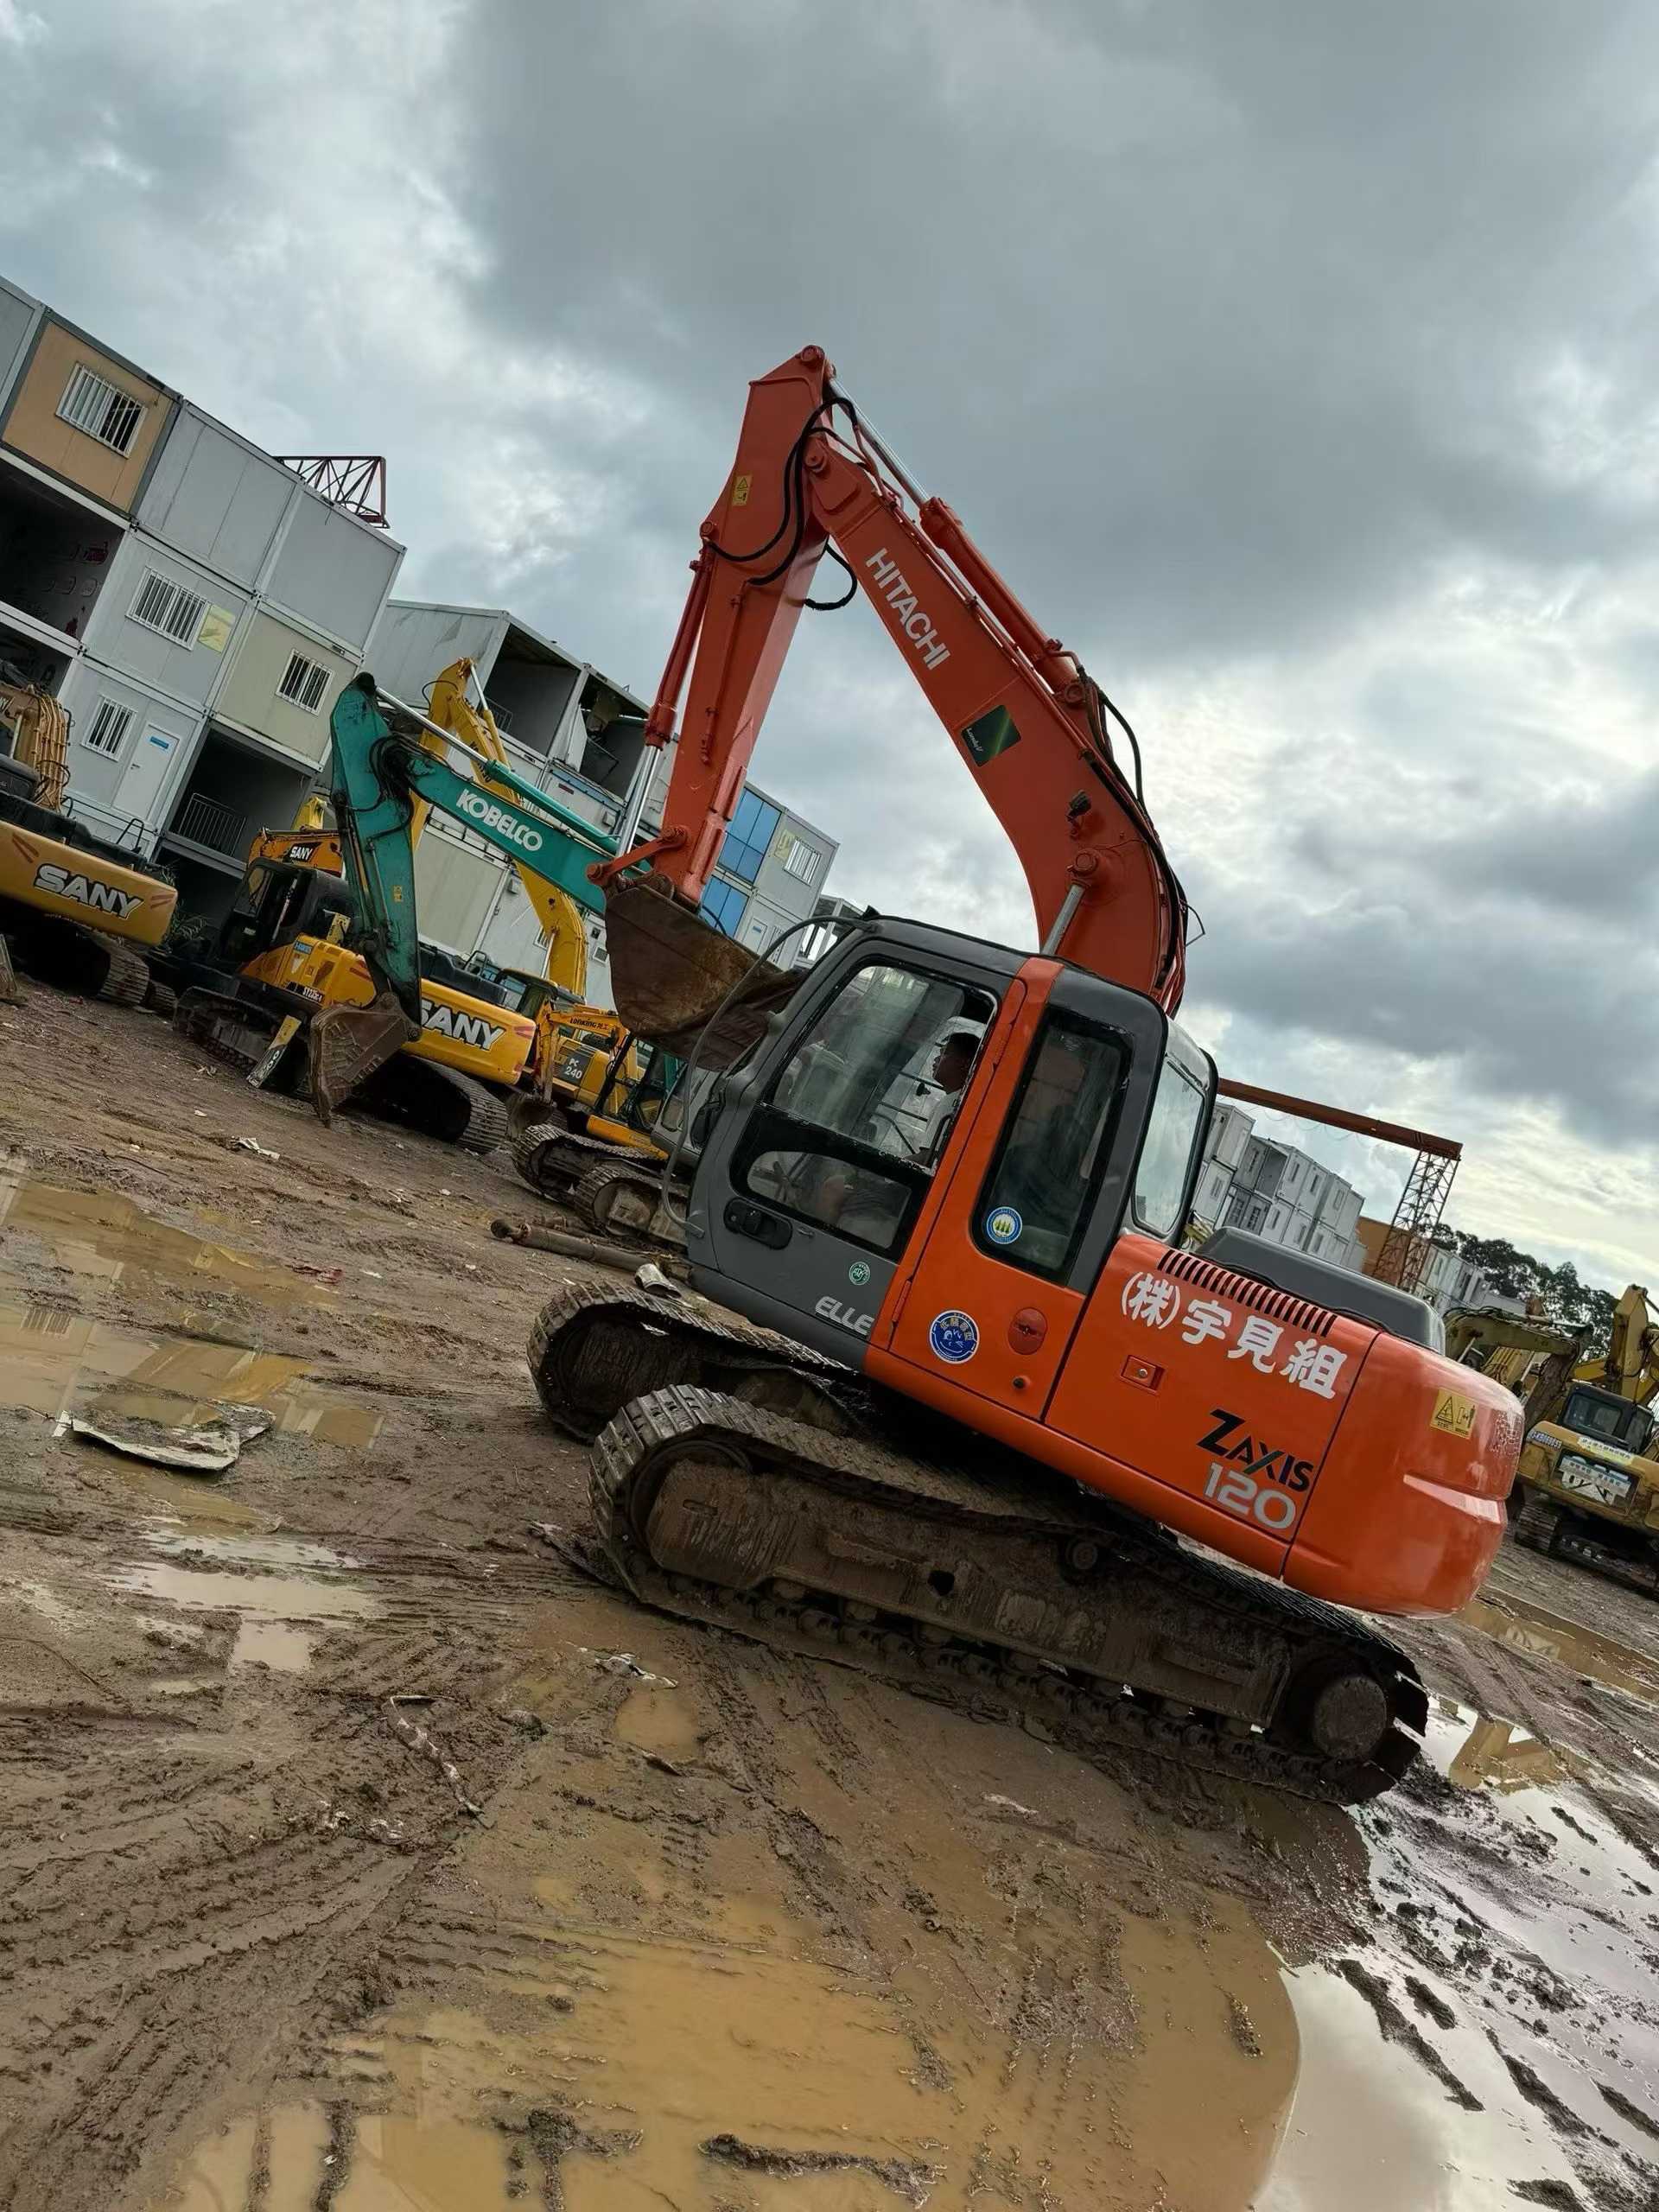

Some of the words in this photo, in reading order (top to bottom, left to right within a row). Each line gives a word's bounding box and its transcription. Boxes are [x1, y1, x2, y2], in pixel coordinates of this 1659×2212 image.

[866, 548, 950, 671] HITACHI
[456, 789, 543, 851] KOBELCO
[289, 846, 313, 861] SANY
[34, 863, 144, 919] SANY
[565, 1065, 583, 1079] 240
[569, 1058, 580, 1067] PC
[1196, 1408, 1314, 1493] ZAXIS
[1204, 1462, 1296, 1529] 120
